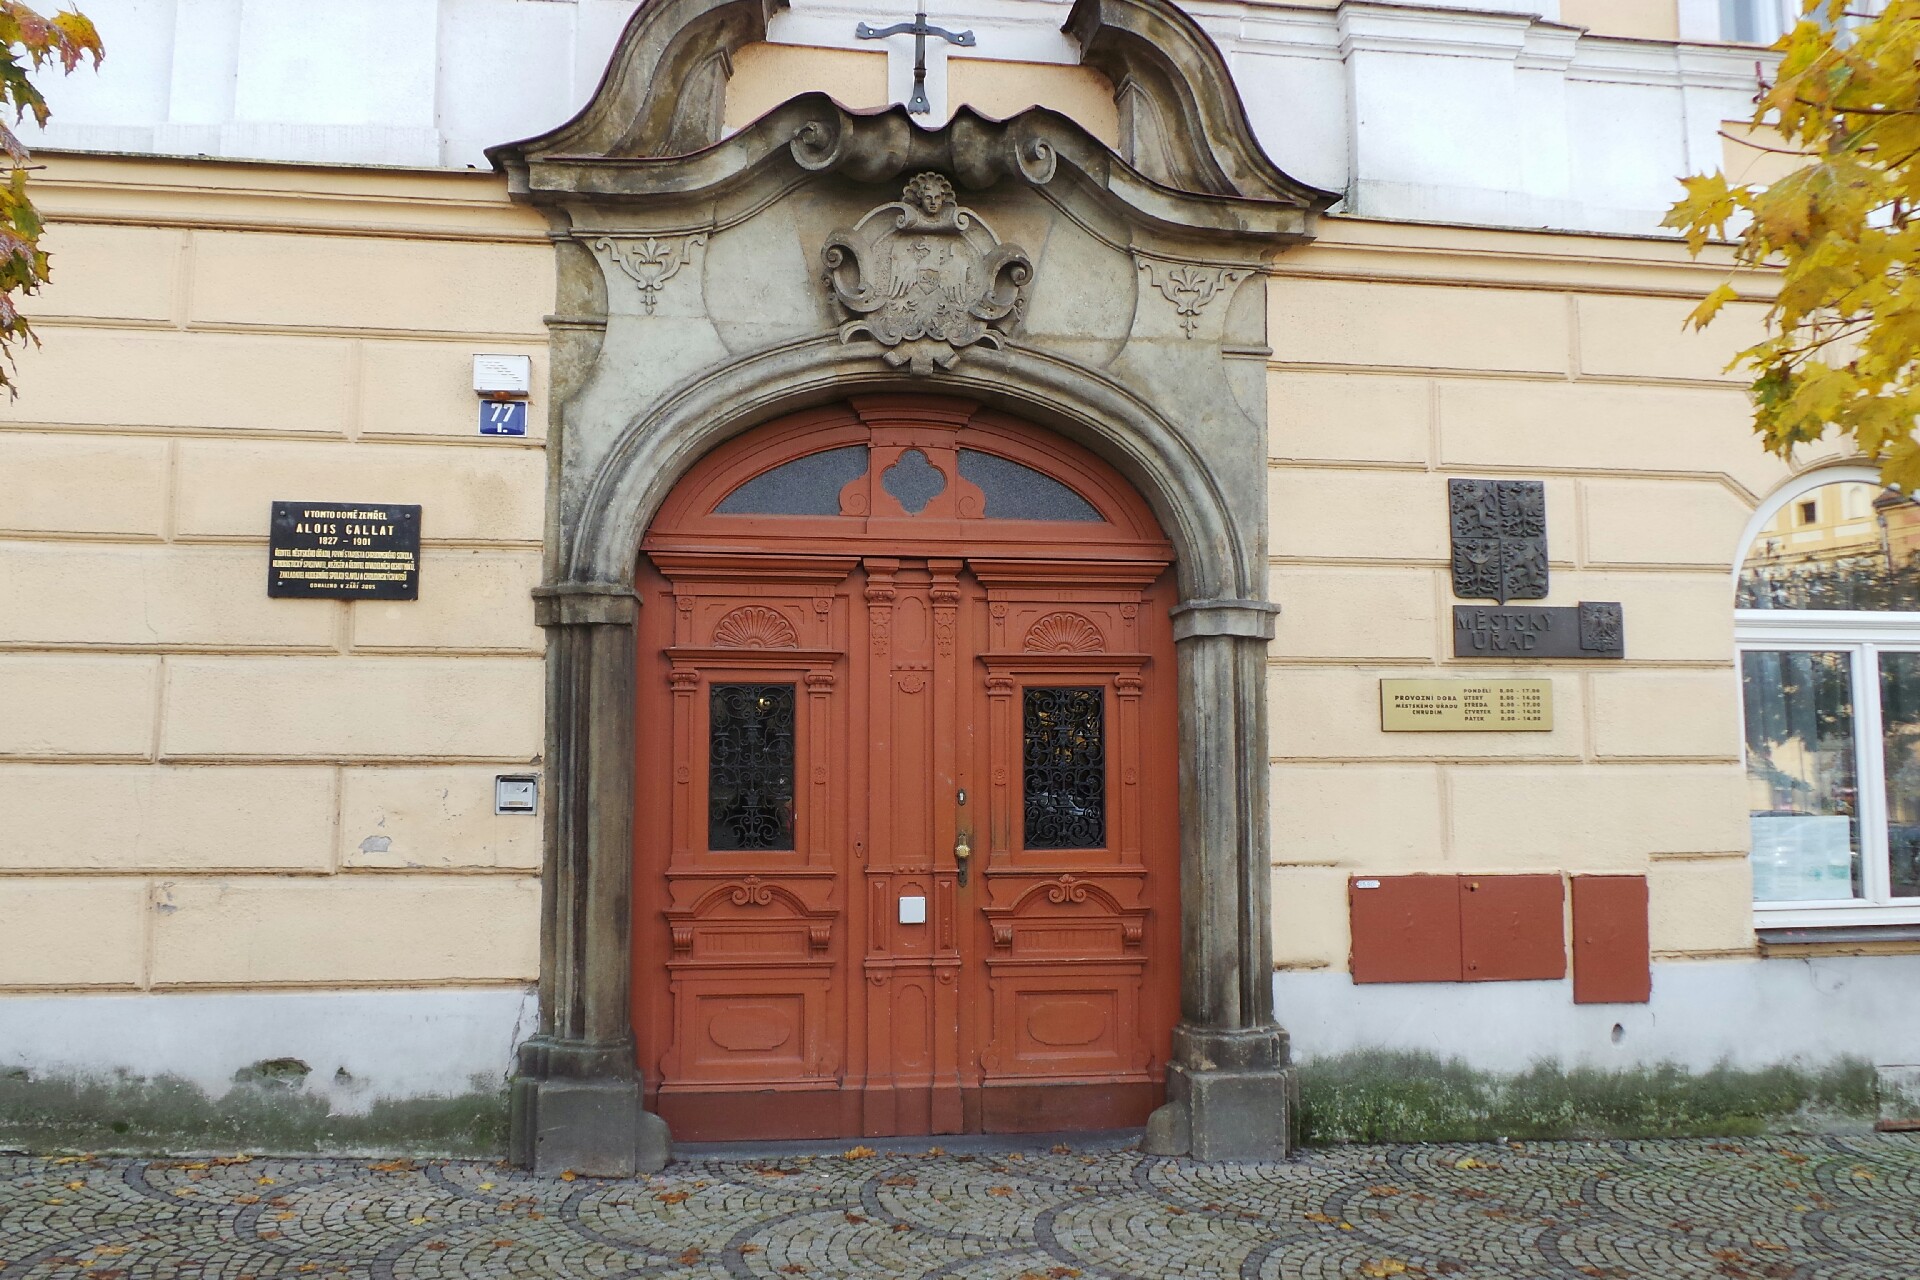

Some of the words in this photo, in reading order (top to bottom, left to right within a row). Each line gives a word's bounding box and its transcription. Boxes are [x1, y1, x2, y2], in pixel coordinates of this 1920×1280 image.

[491, 403, 515, 422] 77
[304, 510, 310, 518] V
[311, 511, 335, 519] TOMTO
[337, 510, 357, 519] DOMĚ
[296, 523, 336, 534] ALOIS
[345, 525, 394, 536] GALLAT
[319, 537, 338, 545] 1827
[353, 537, 371, 546] 1901
